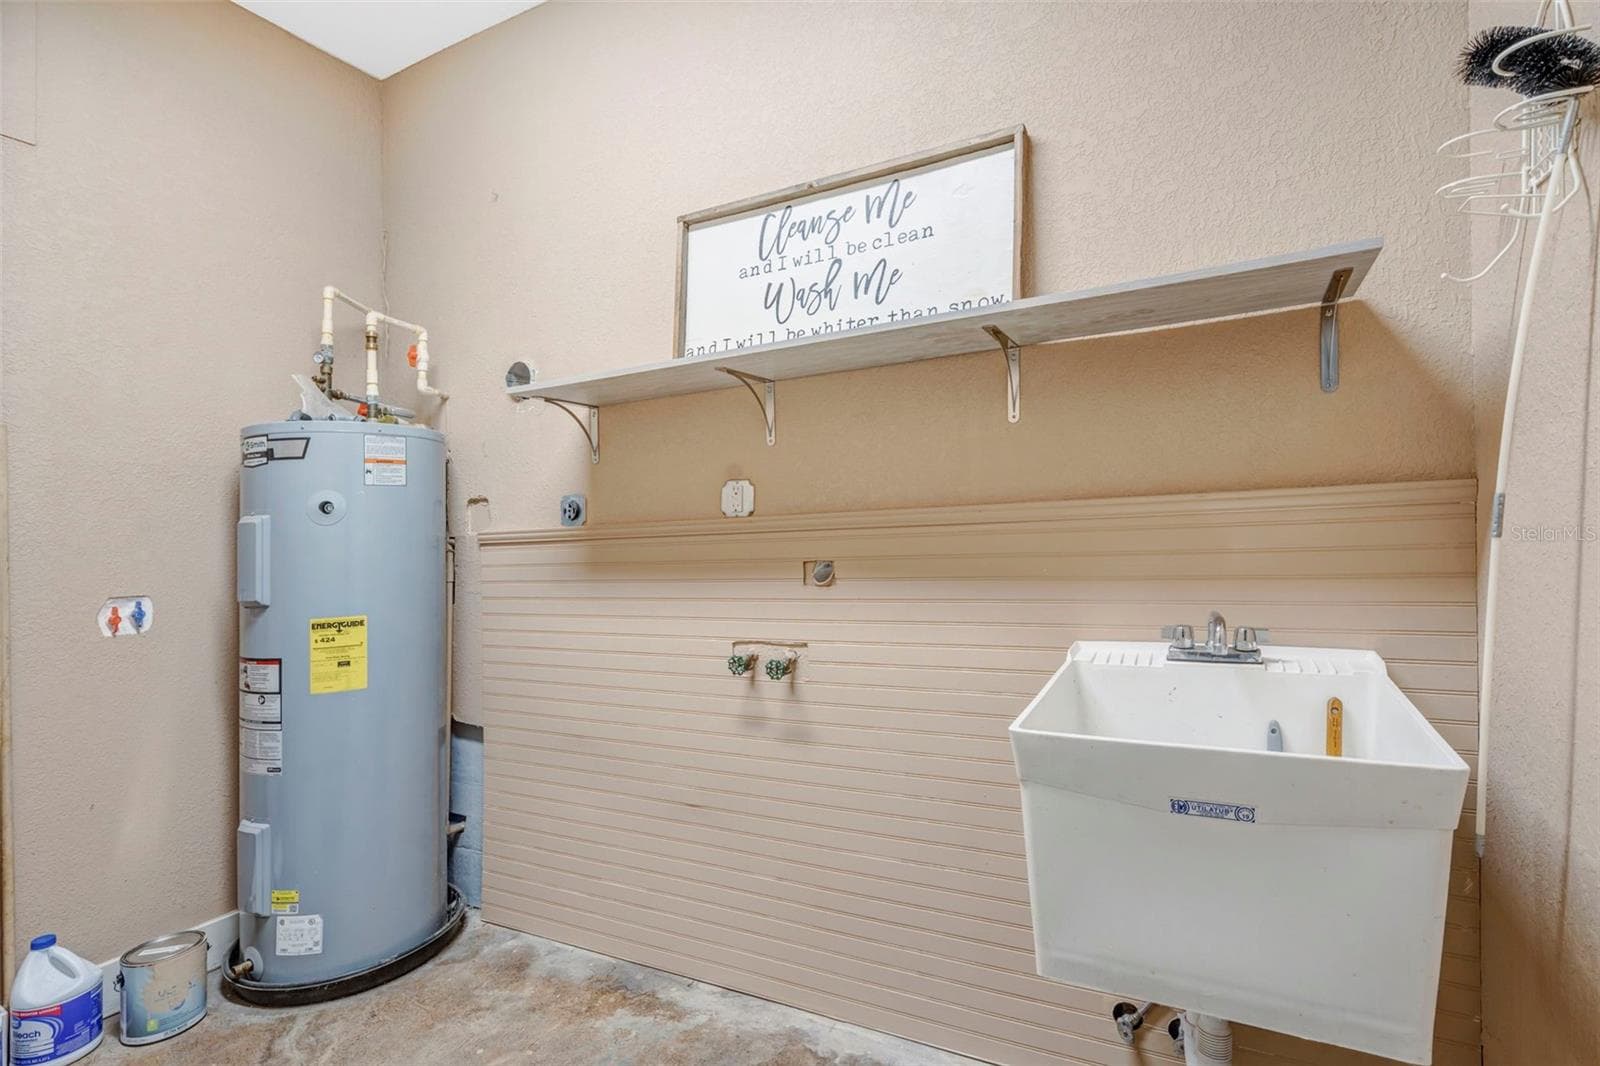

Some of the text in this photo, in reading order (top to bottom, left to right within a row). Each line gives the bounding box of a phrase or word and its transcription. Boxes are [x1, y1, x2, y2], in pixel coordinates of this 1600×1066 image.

[758, 178, 917, 261] Cleanse Me
[738, 225, 934, 279] and I will be clean
[764, 258, 903, 325] Wash Me
[810, 316, 879, 336] whiter
[887, 306, 938, 323] than
